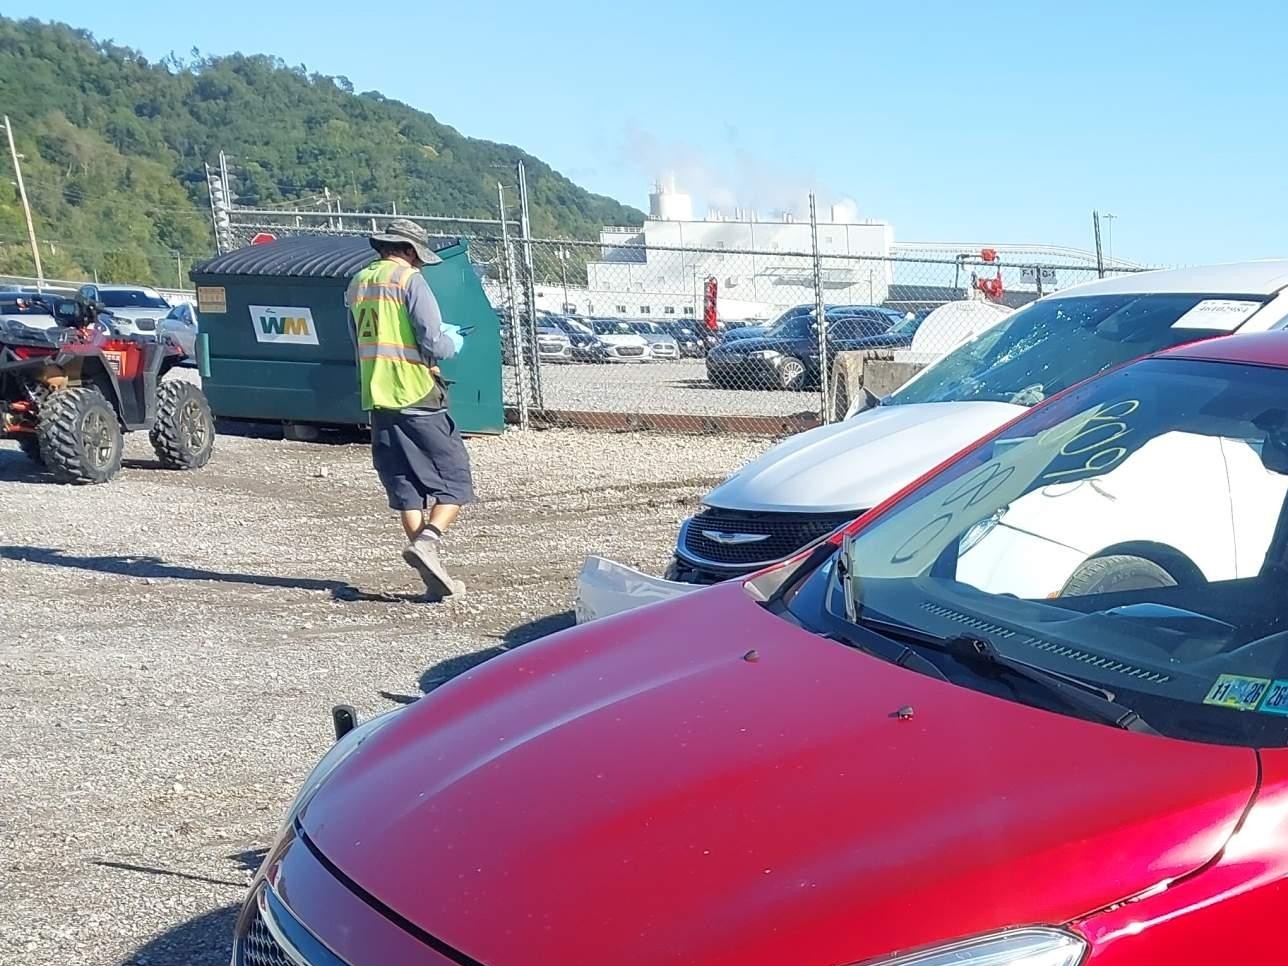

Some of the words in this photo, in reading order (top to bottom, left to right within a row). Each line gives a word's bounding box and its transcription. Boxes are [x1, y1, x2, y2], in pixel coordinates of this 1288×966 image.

[259, 315, 310, 336] WM
[1211, 682, 1232, 702] 11
[1267, 685, 1288, 707] 26
